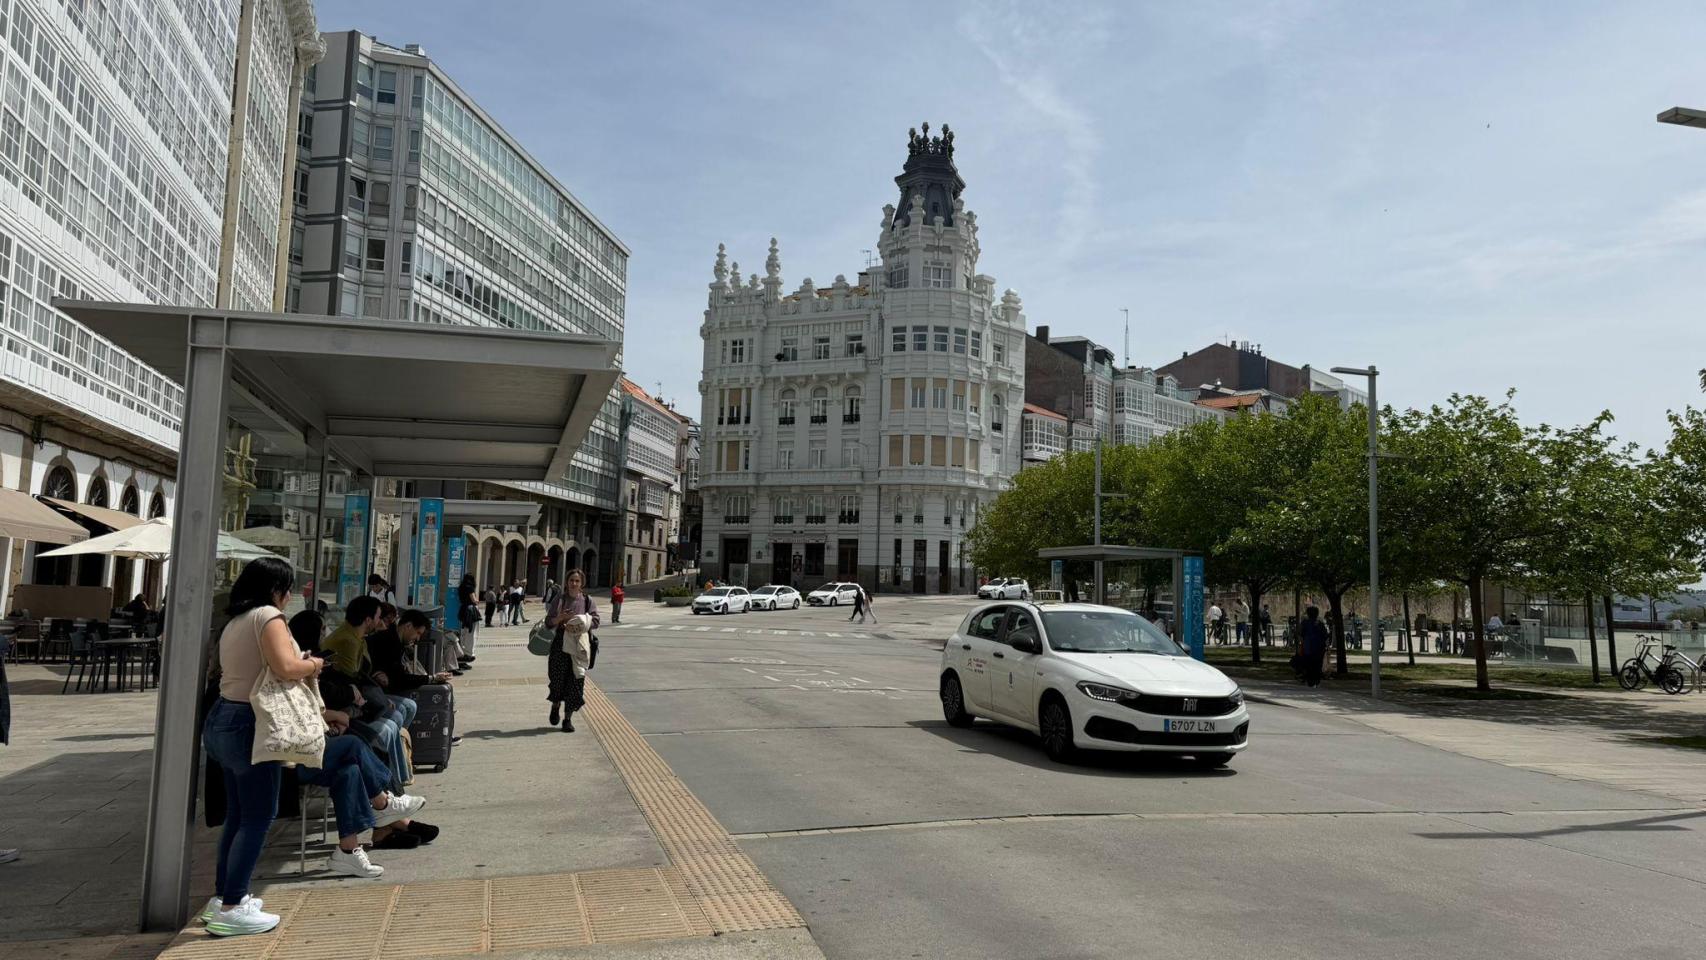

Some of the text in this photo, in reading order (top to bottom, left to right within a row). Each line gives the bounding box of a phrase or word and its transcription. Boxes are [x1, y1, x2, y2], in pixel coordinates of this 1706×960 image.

[1041, 592, 1056, 600] TAXI
[1183, 698, 1198, 712] FIAT
[1171, 721, 1216, 732] 6707 LZN
